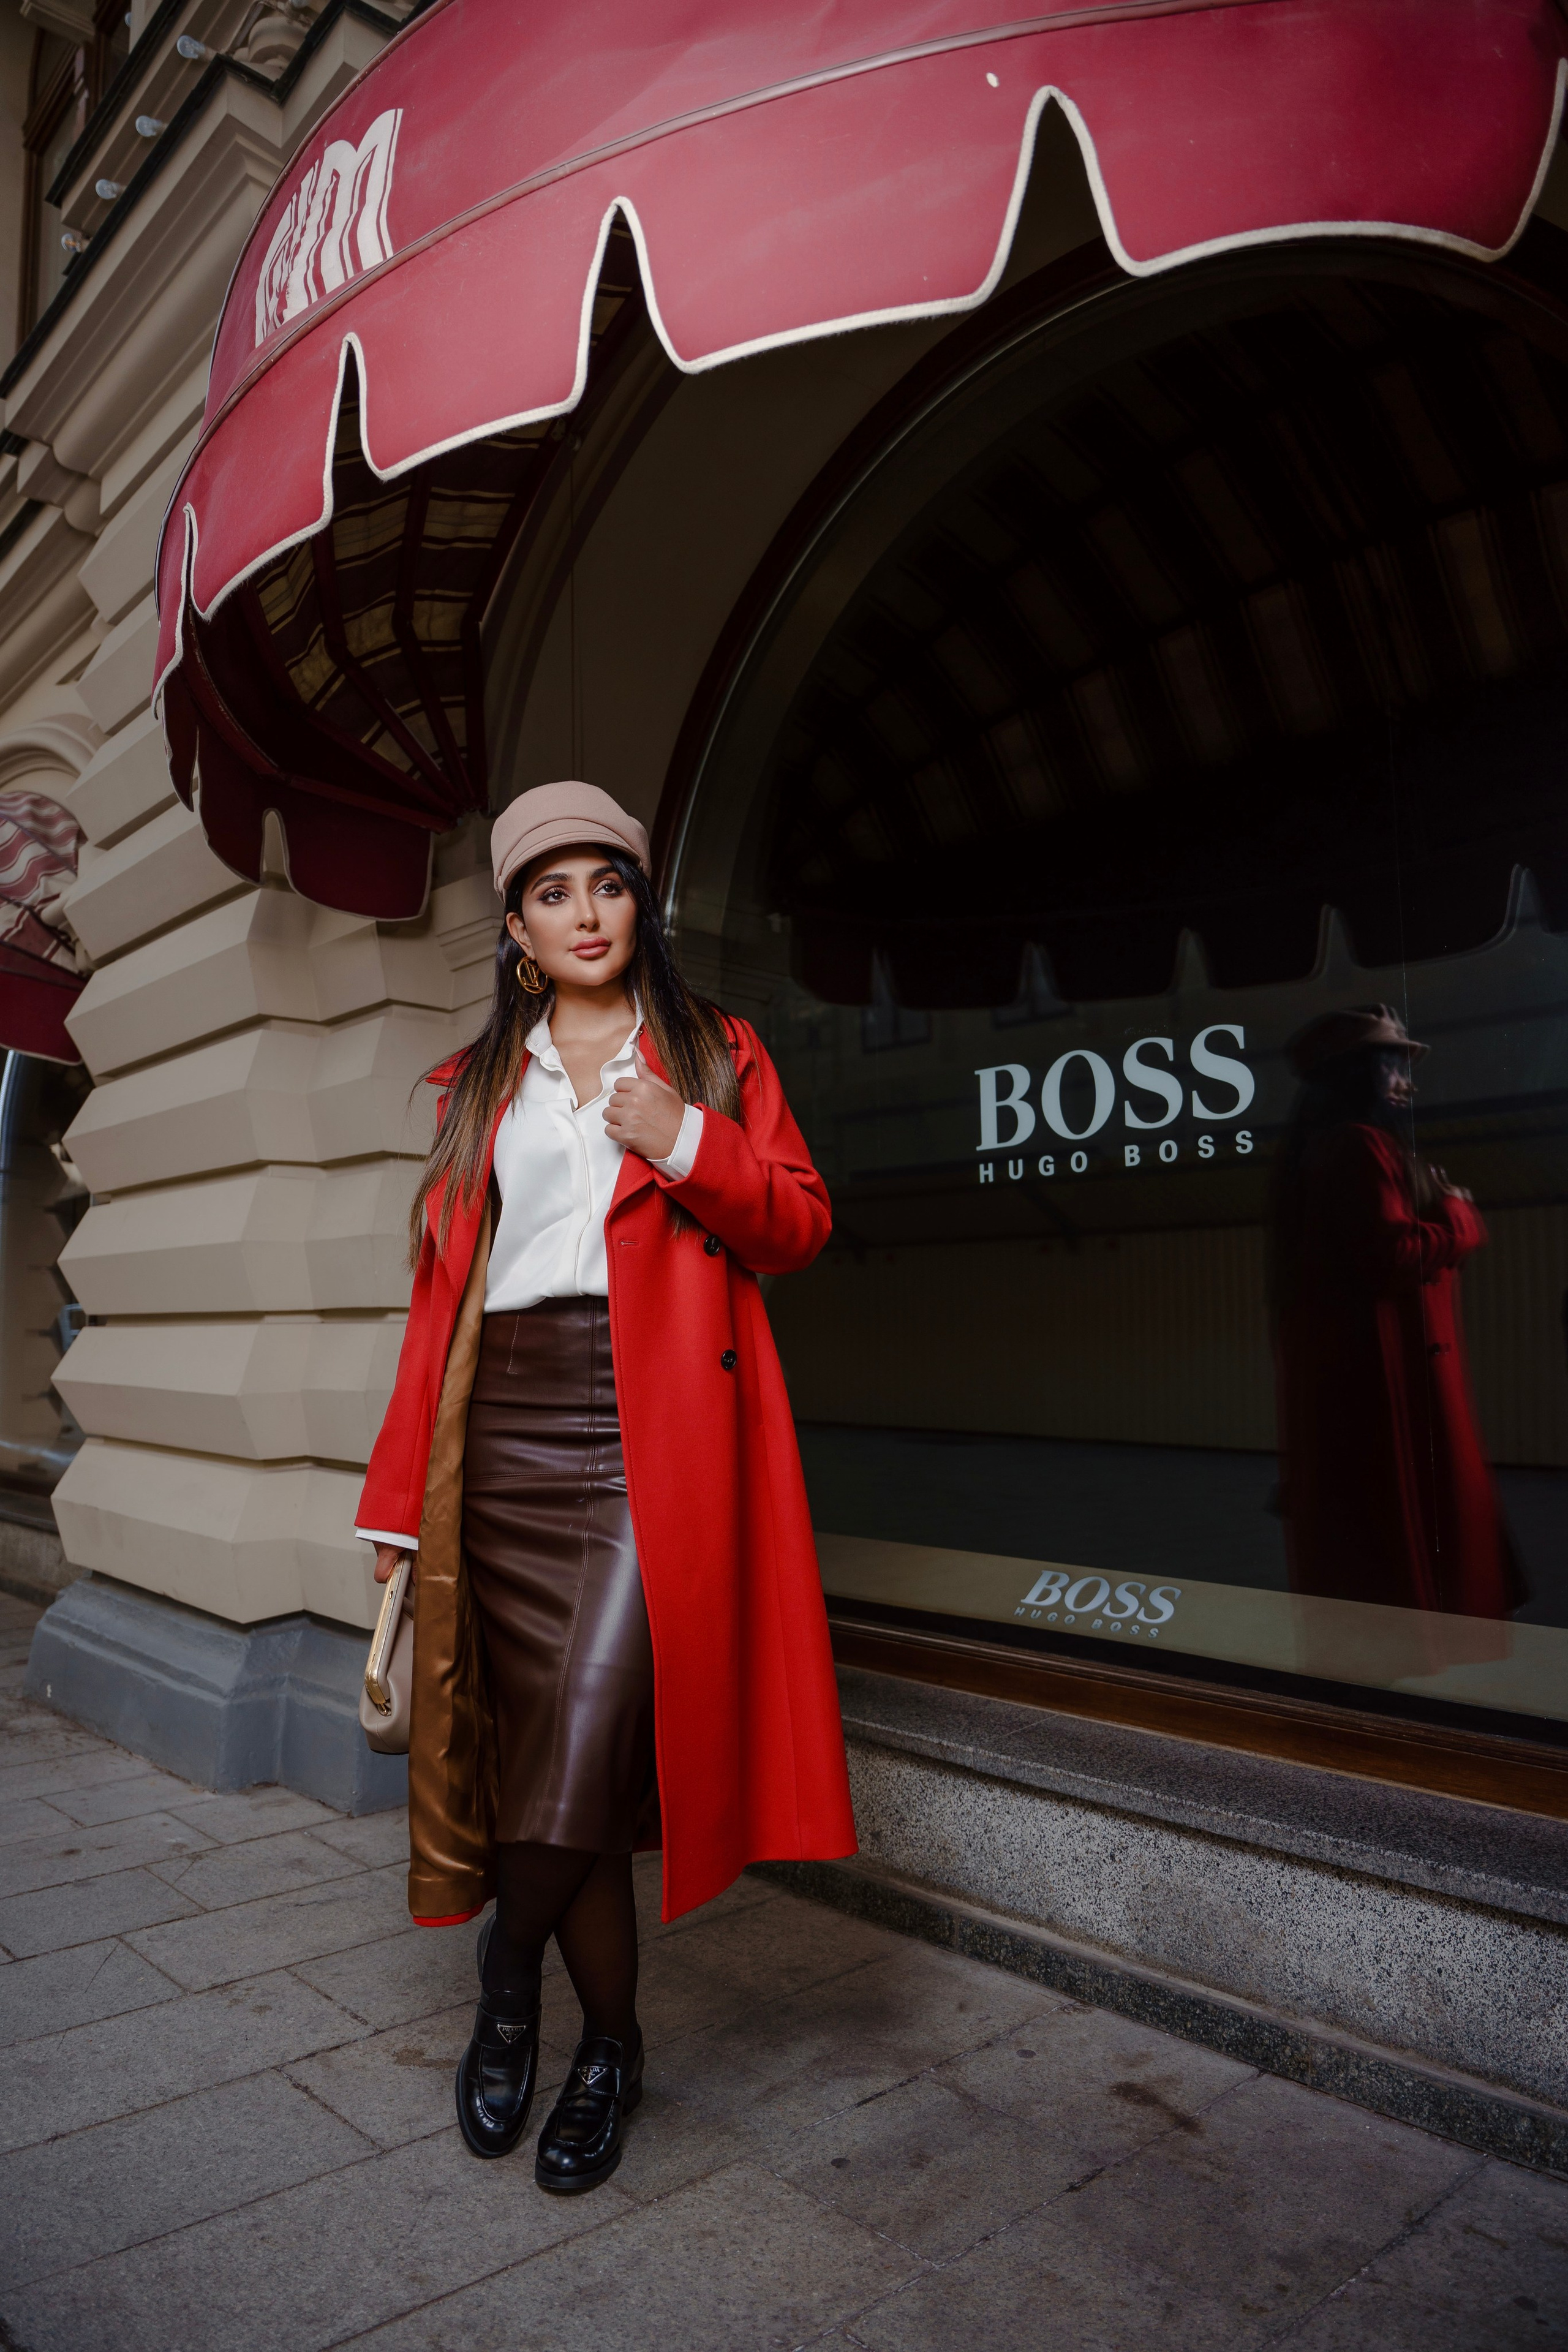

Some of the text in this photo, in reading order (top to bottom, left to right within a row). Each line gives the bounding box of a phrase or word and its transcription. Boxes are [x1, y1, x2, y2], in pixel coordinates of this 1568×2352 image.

[974, 1023, 1255, 1152] BOSS
[979, 1130, 1253, 1183] HUGO BOSS
[1014, 1607, 1159, 1638] HUGO BOSS
[1020, 1570, 1182, 1624] BOSS
